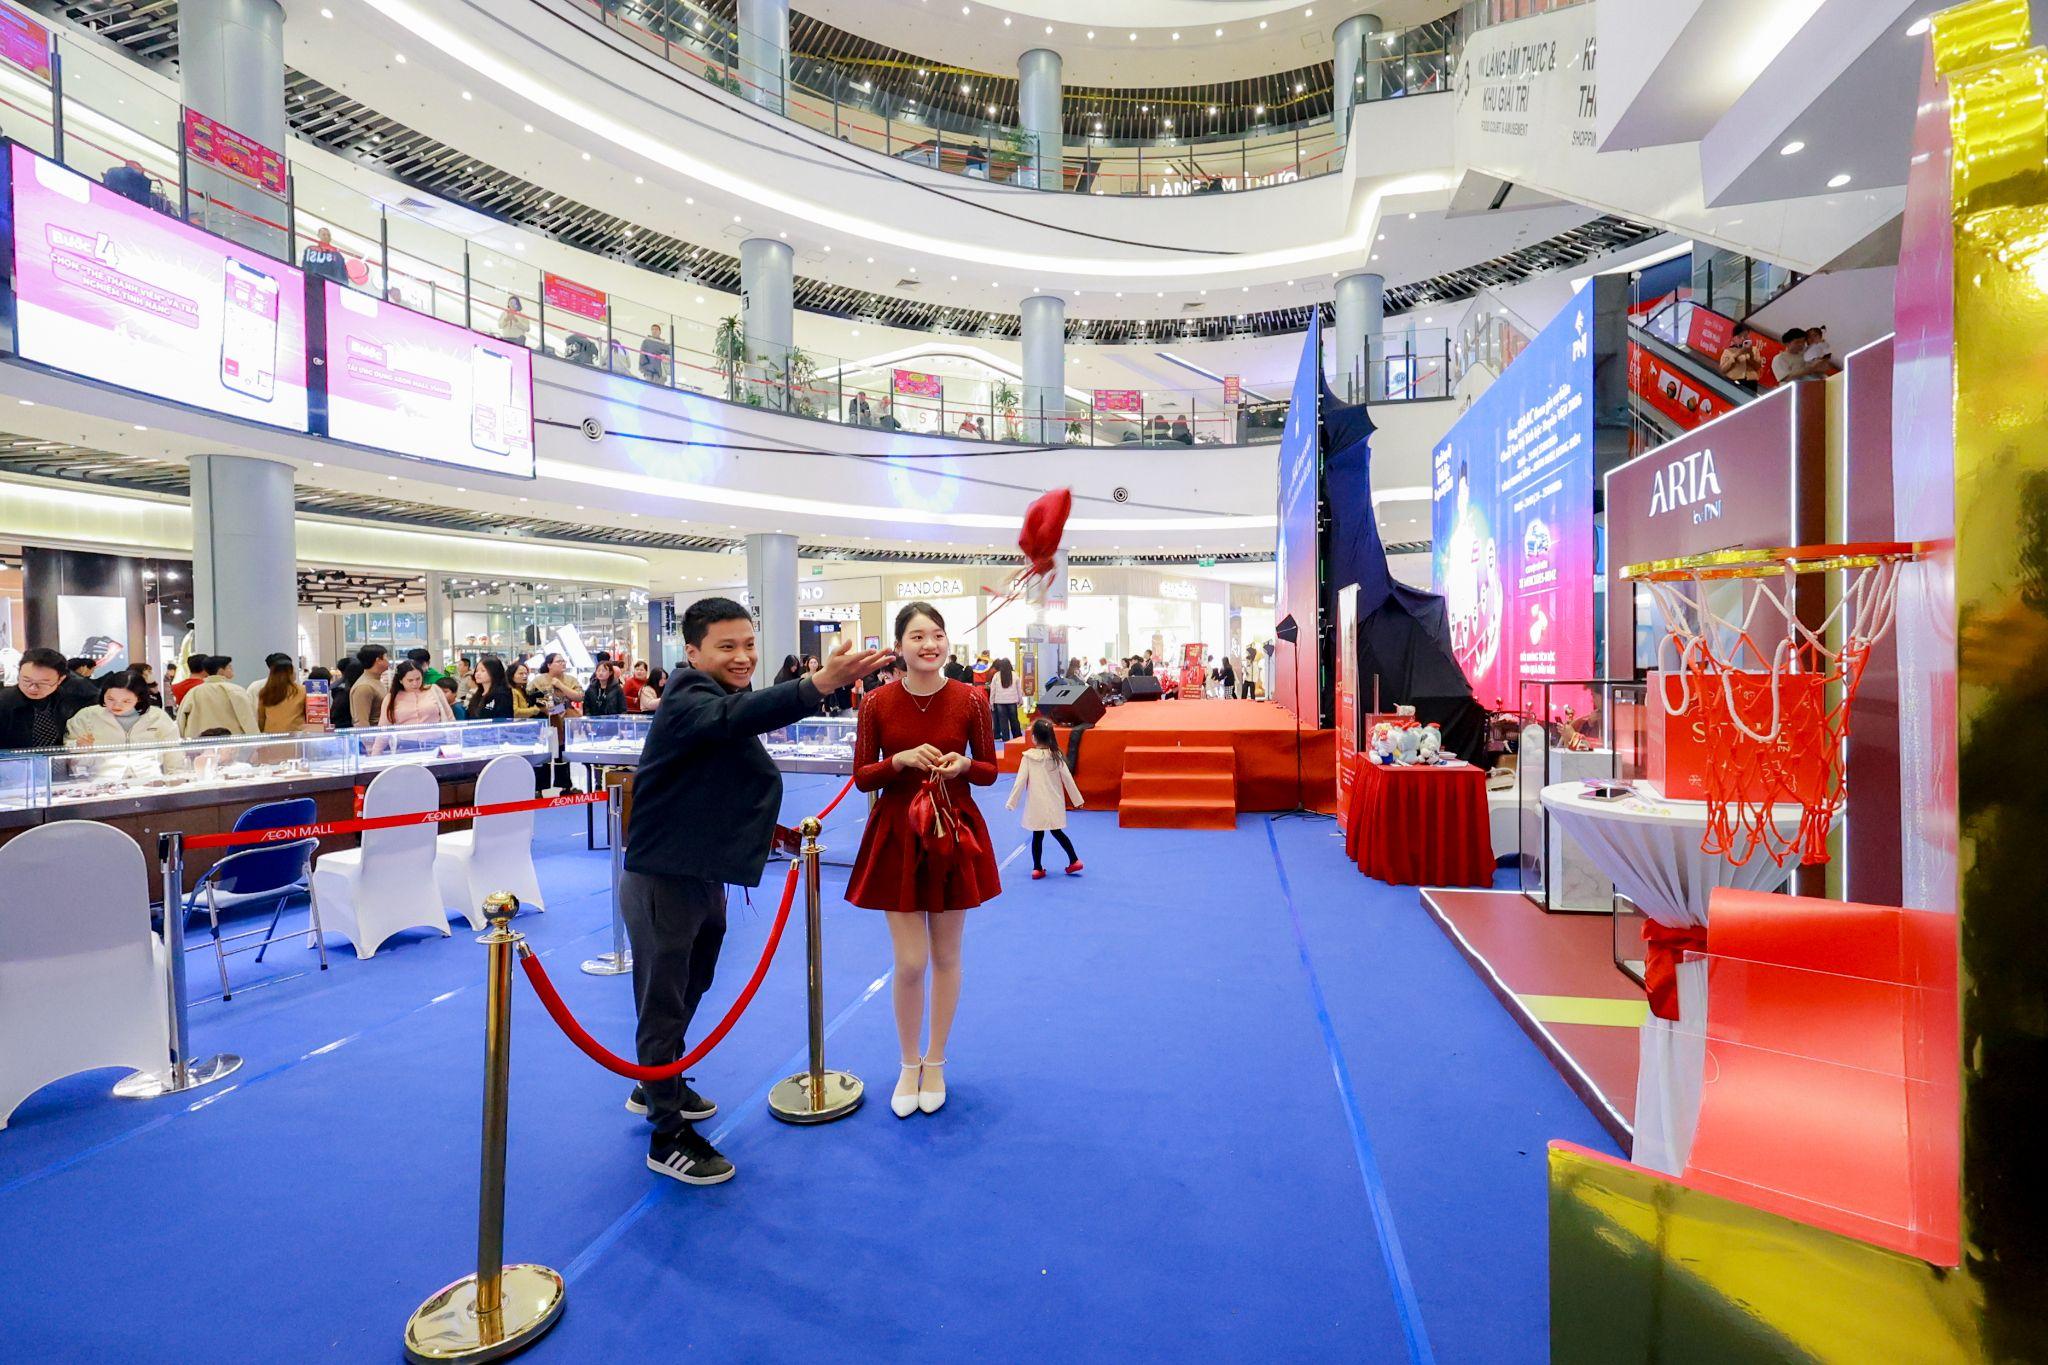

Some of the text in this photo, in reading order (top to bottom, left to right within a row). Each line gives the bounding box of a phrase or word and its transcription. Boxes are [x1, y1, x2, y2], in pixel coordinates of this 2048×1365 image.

[1548, 41, 1556, 71] &
[1482, 87, 1498, 112] KHU
[94, 231, 119, 269] 4
[1648, 448, 1721, 517] ARTA
[898, 580, 961, 597] PANDORA
[1013, 578, 1092, 592] PARA
[576, 792, 600, 804] MALL
[453, 806, 482, 819] MALL
[299, 824, 335, 838] MALL
